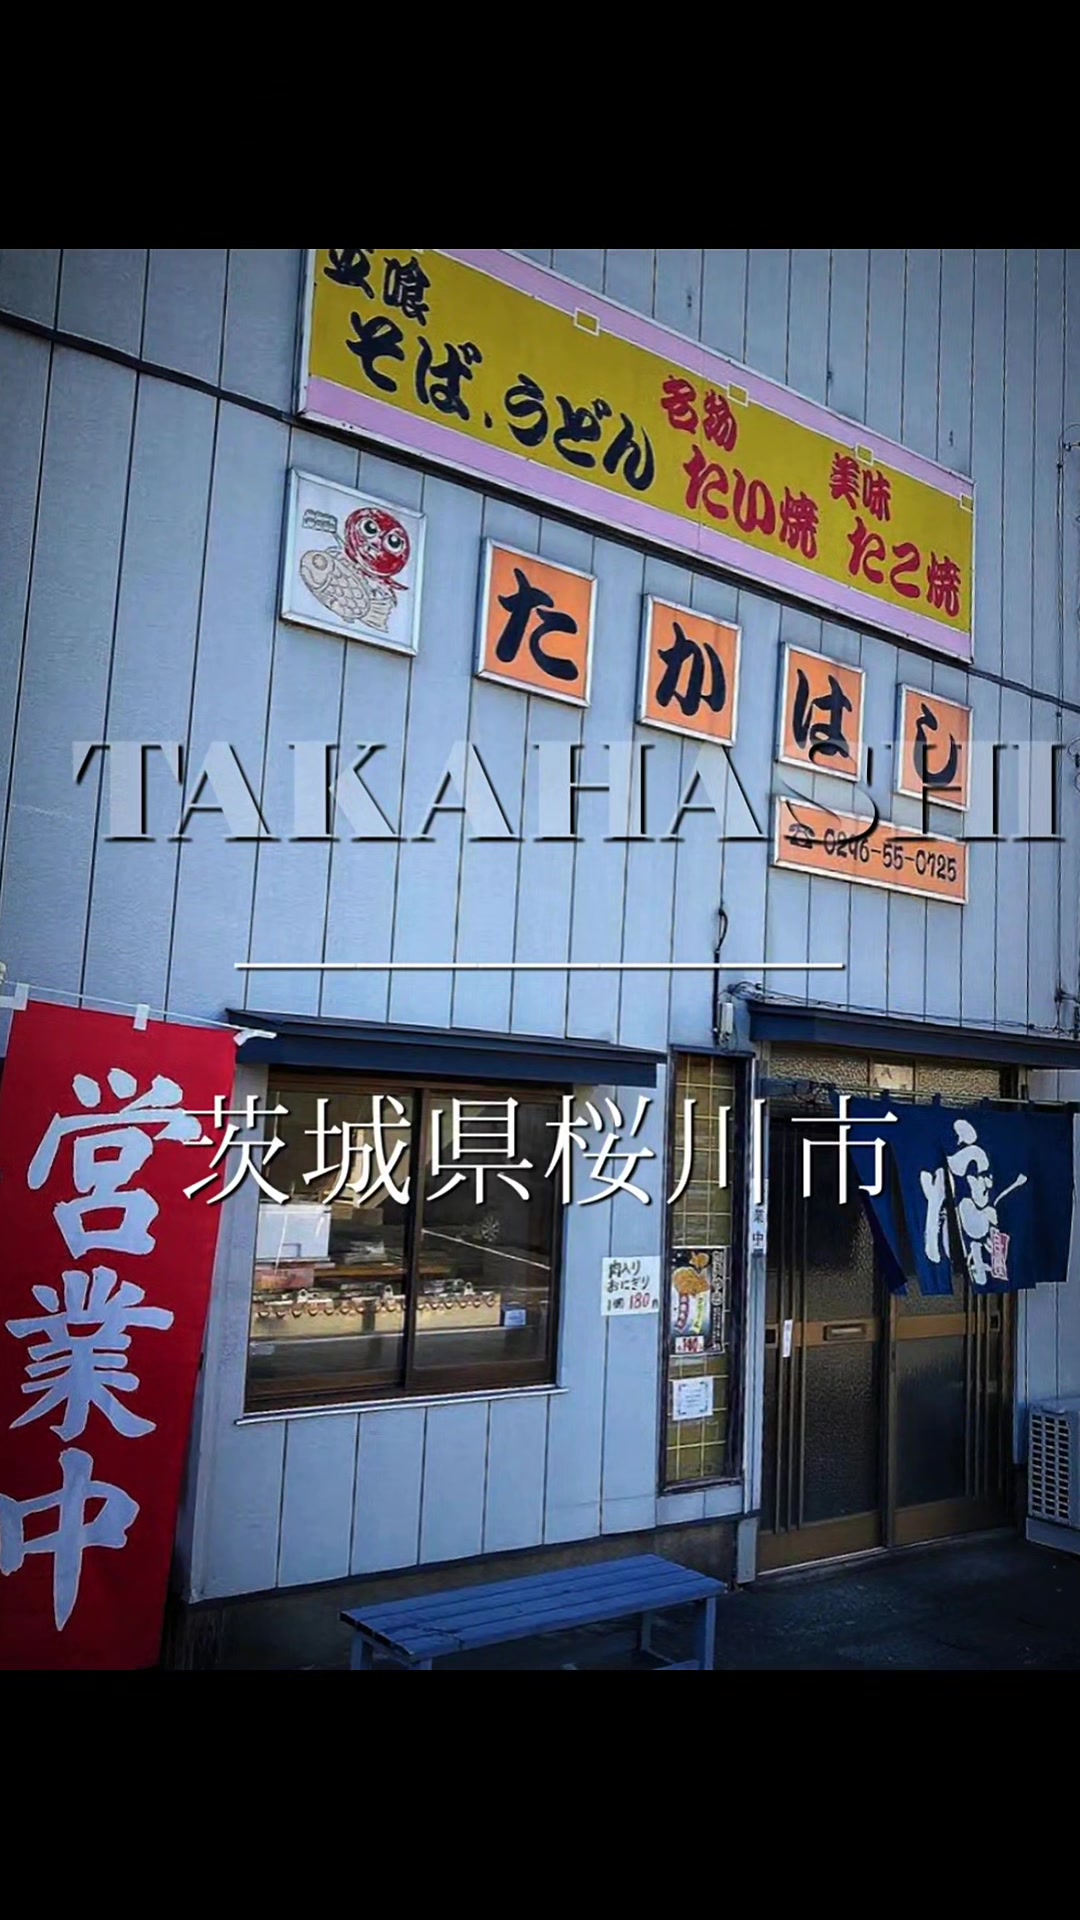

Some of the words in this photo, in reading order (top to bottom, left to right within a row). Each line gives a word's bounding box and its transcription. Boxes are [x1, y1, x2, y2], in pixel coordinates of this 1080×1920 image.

[682, 444, 819, 560] たい焼
[829, 452, 892, 522] 美味
[847, 516, 961, 618] たこ焼
[0, 1067, 203, 1632] 営業中
